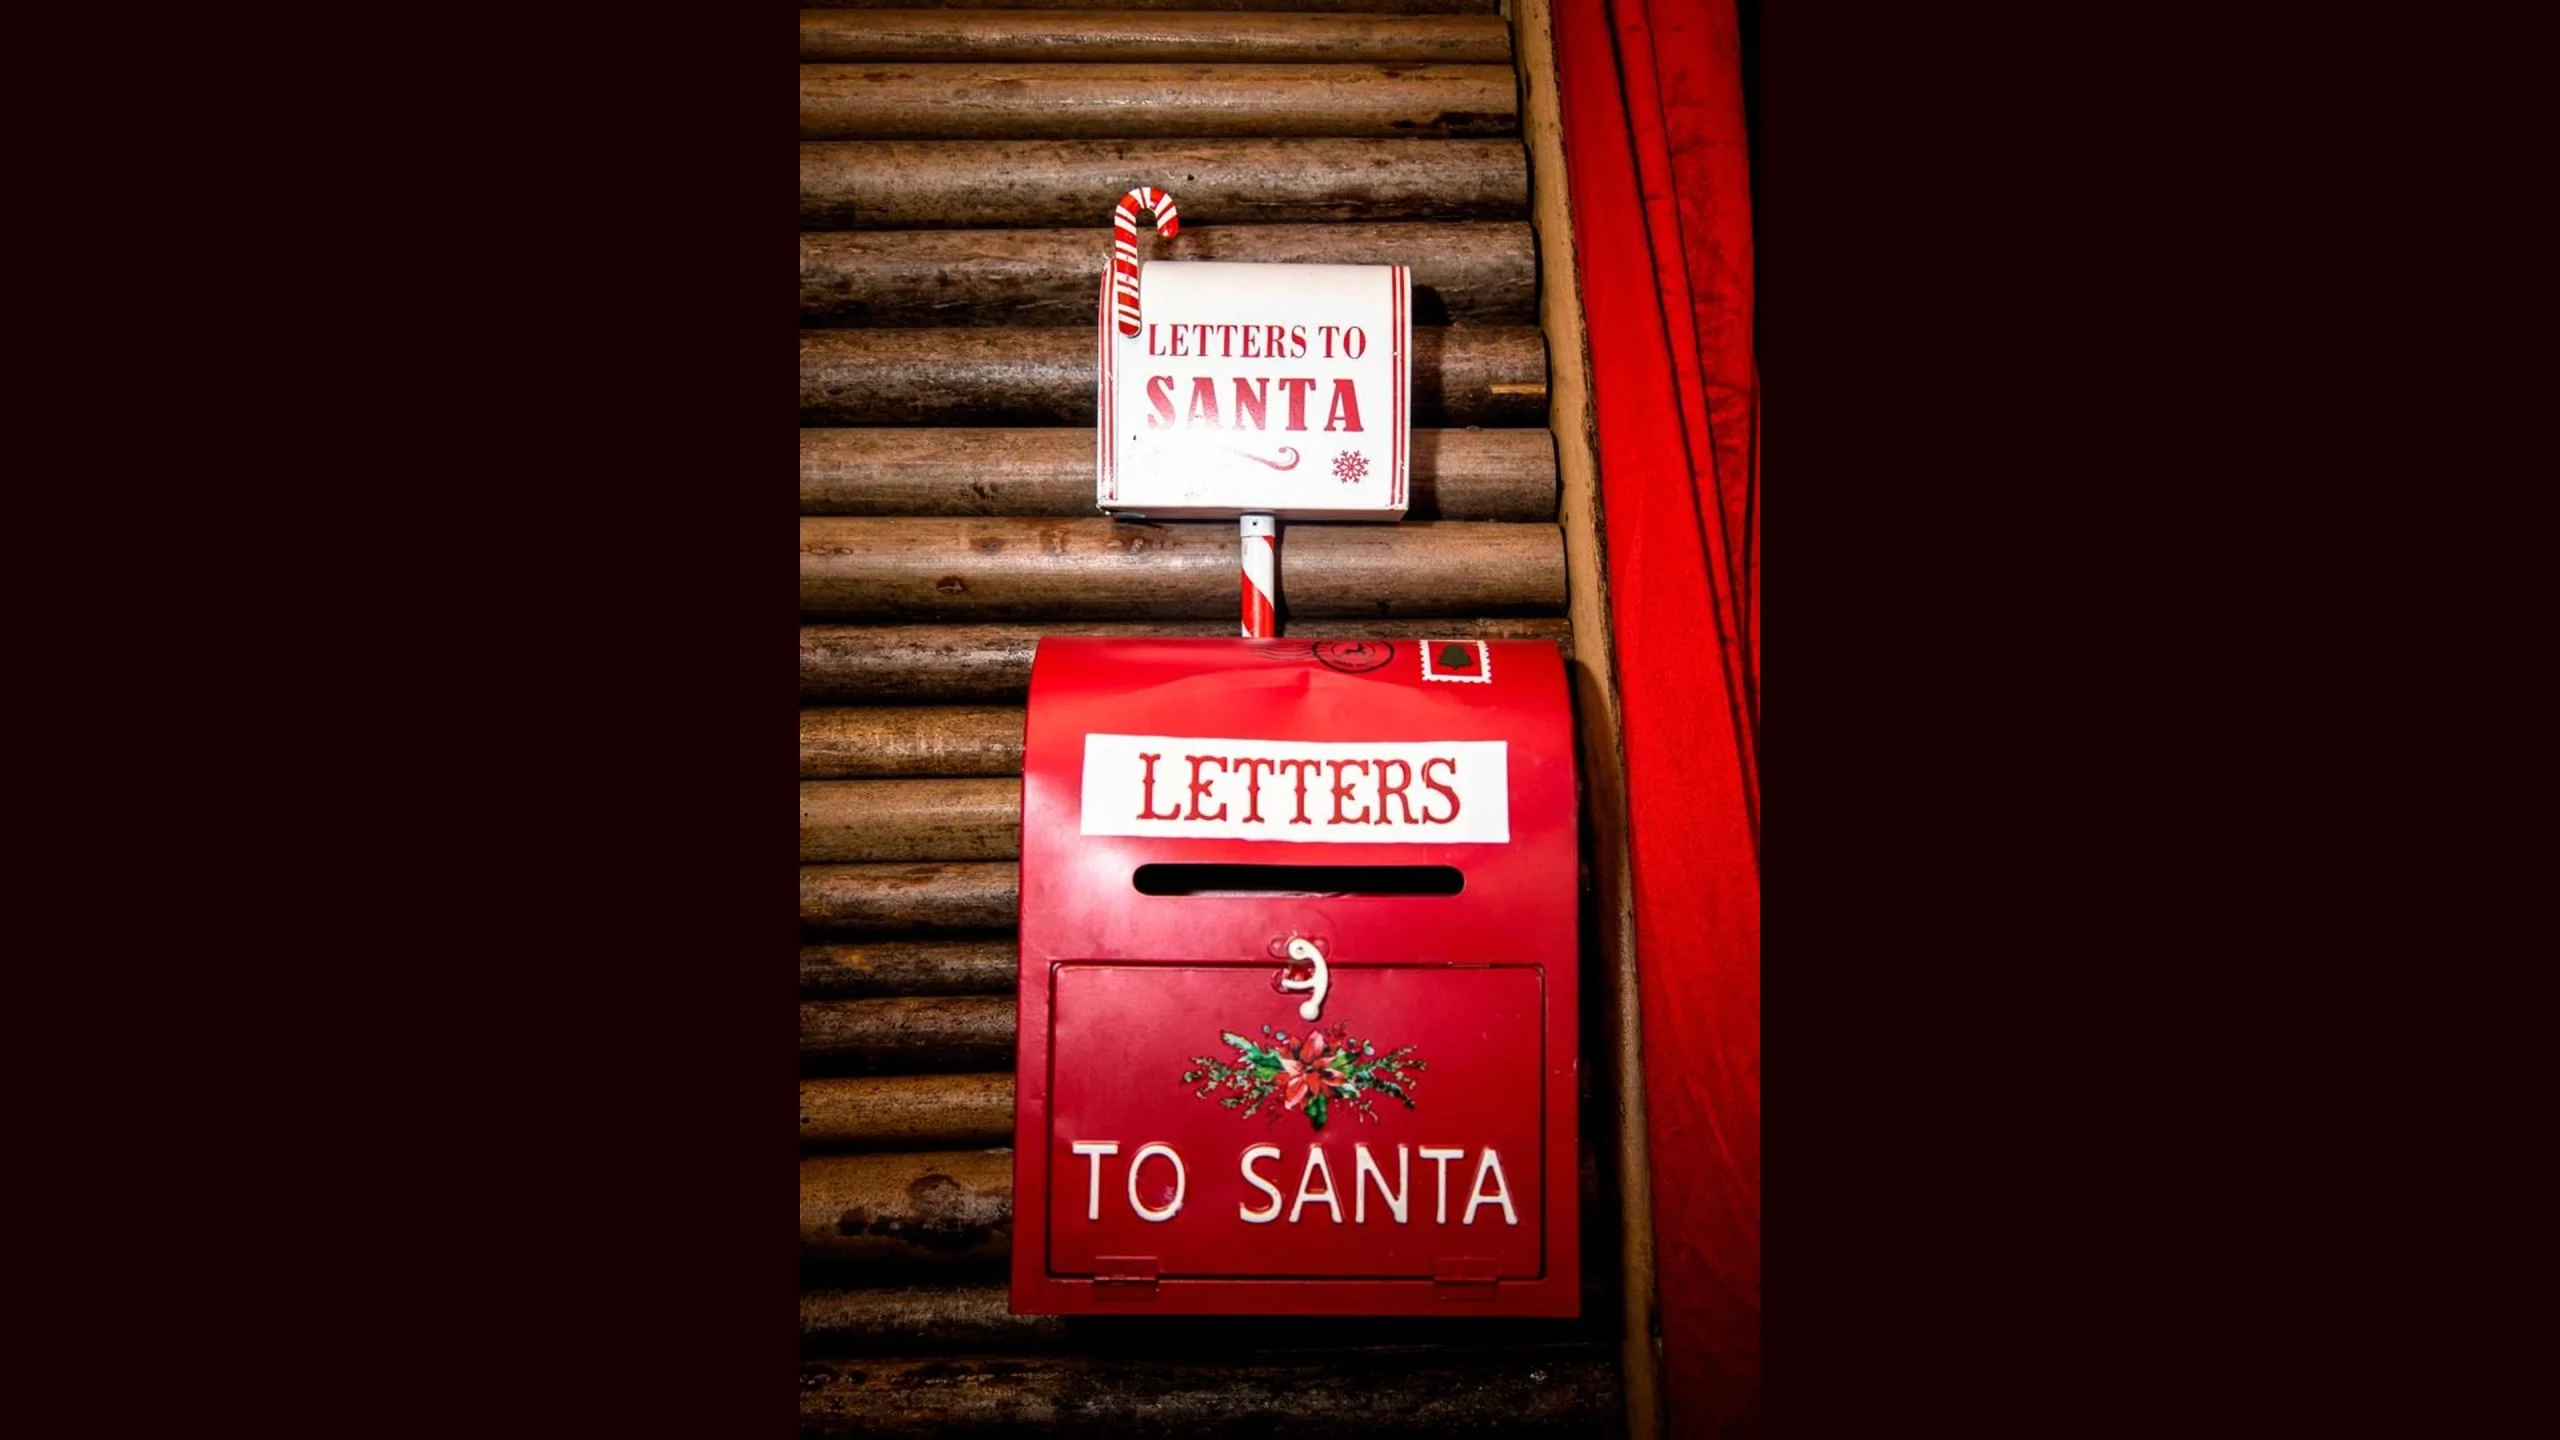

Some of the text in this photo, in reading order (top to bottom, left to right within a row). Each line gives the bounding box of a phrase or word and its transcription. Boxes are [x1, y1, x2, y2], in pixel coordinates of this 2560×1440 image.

[1148, 323, 1366, 359] LETTERS TO
[1146, 375, 1364, 432] SANTA
[1136, 752, 1461, 825] LETTERS
[1072, 1142, 1519, 1225] TO SANTA
